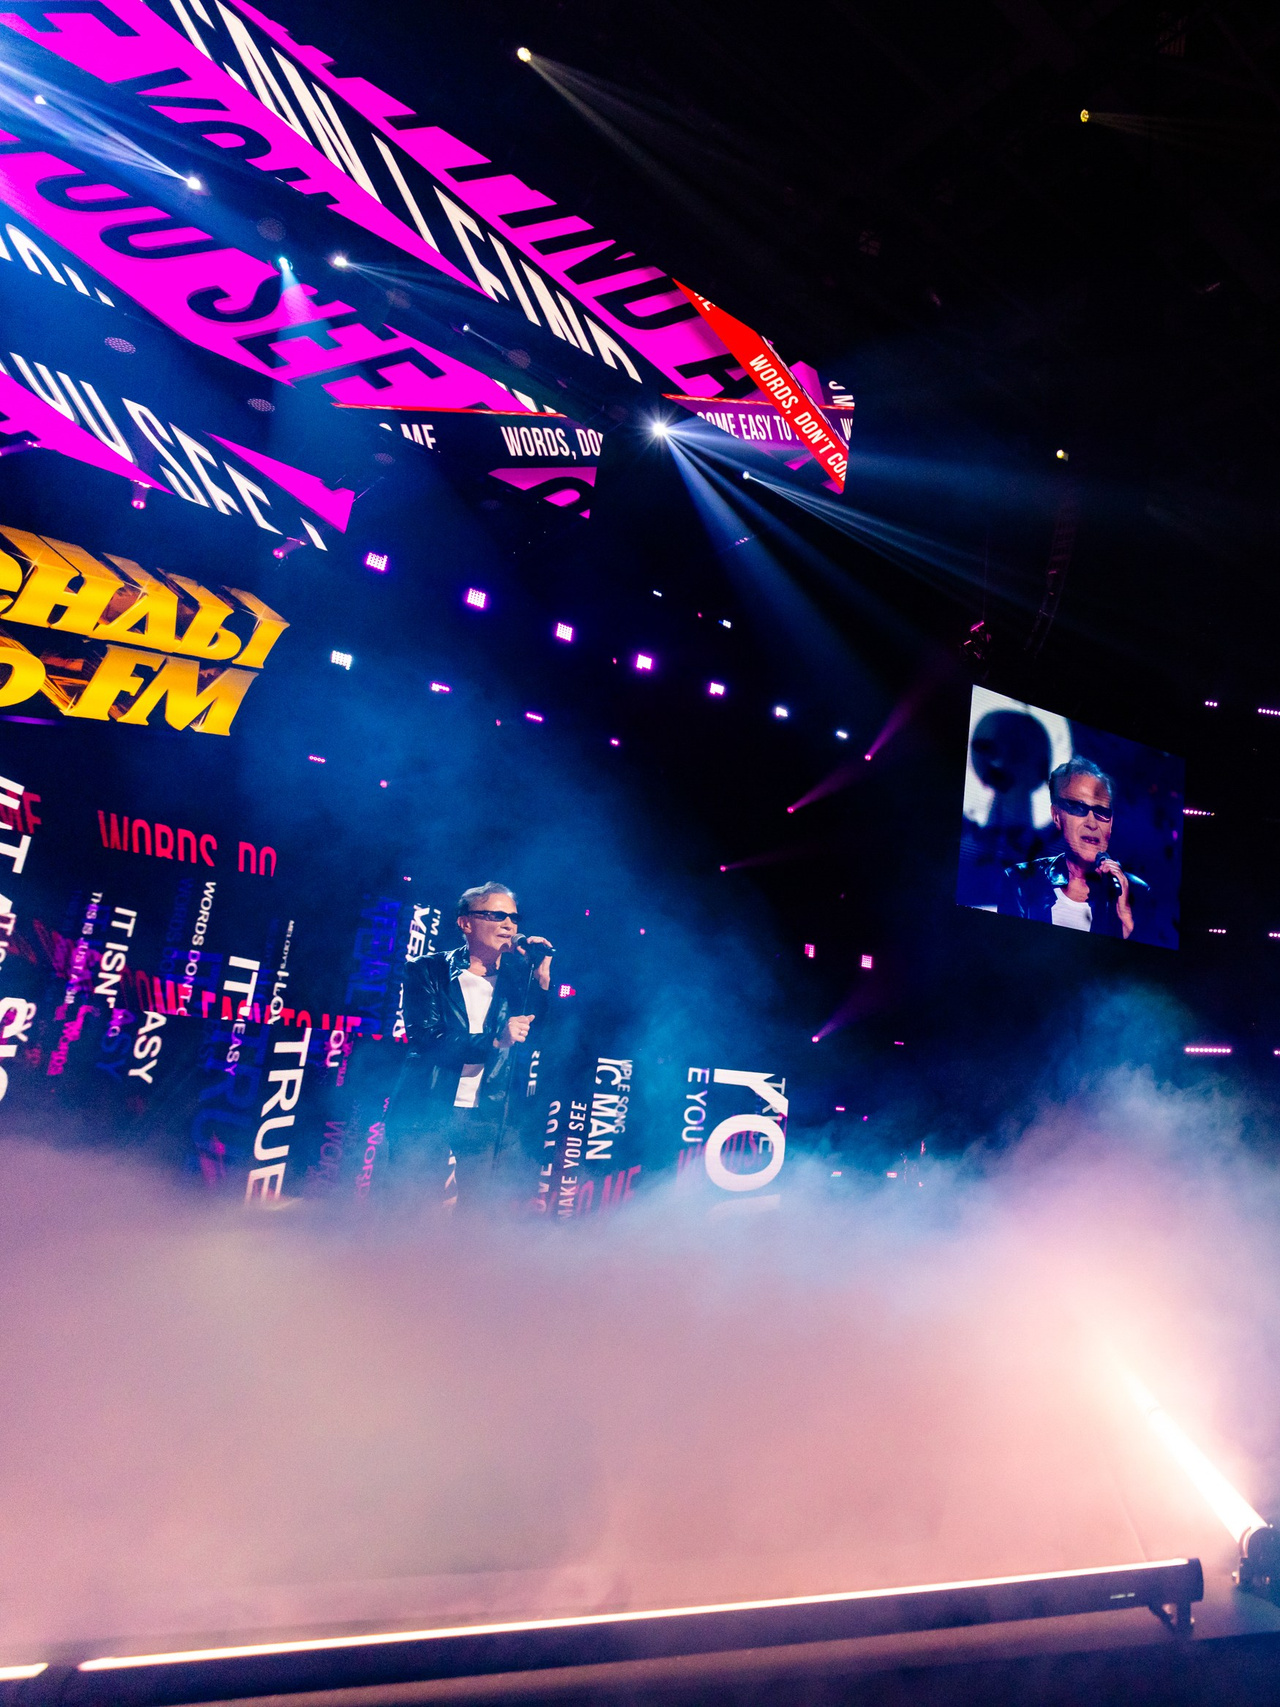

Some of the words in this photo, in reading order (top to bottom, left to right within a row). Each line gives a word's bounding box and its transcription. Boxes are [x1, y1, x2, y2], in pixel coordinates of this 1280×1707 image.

[749, 353, 799, 415] WORDS,
[793, 411, 836, 455] DON'T
[500, 425, 577, 461] WORDS,
[737, 413, 773, 441] EASY
[60, 644, 259, 736] FM
[110, 906, 138, 938] IT
[191, 881, 217, 946] WORDS
[244, 1027, 313, 1208] TRUE
[568, 1100, 587, 1132] SEE
[681, 1089, 708, 1143] YOU
[563, 1136, 583, 1169] YOU
